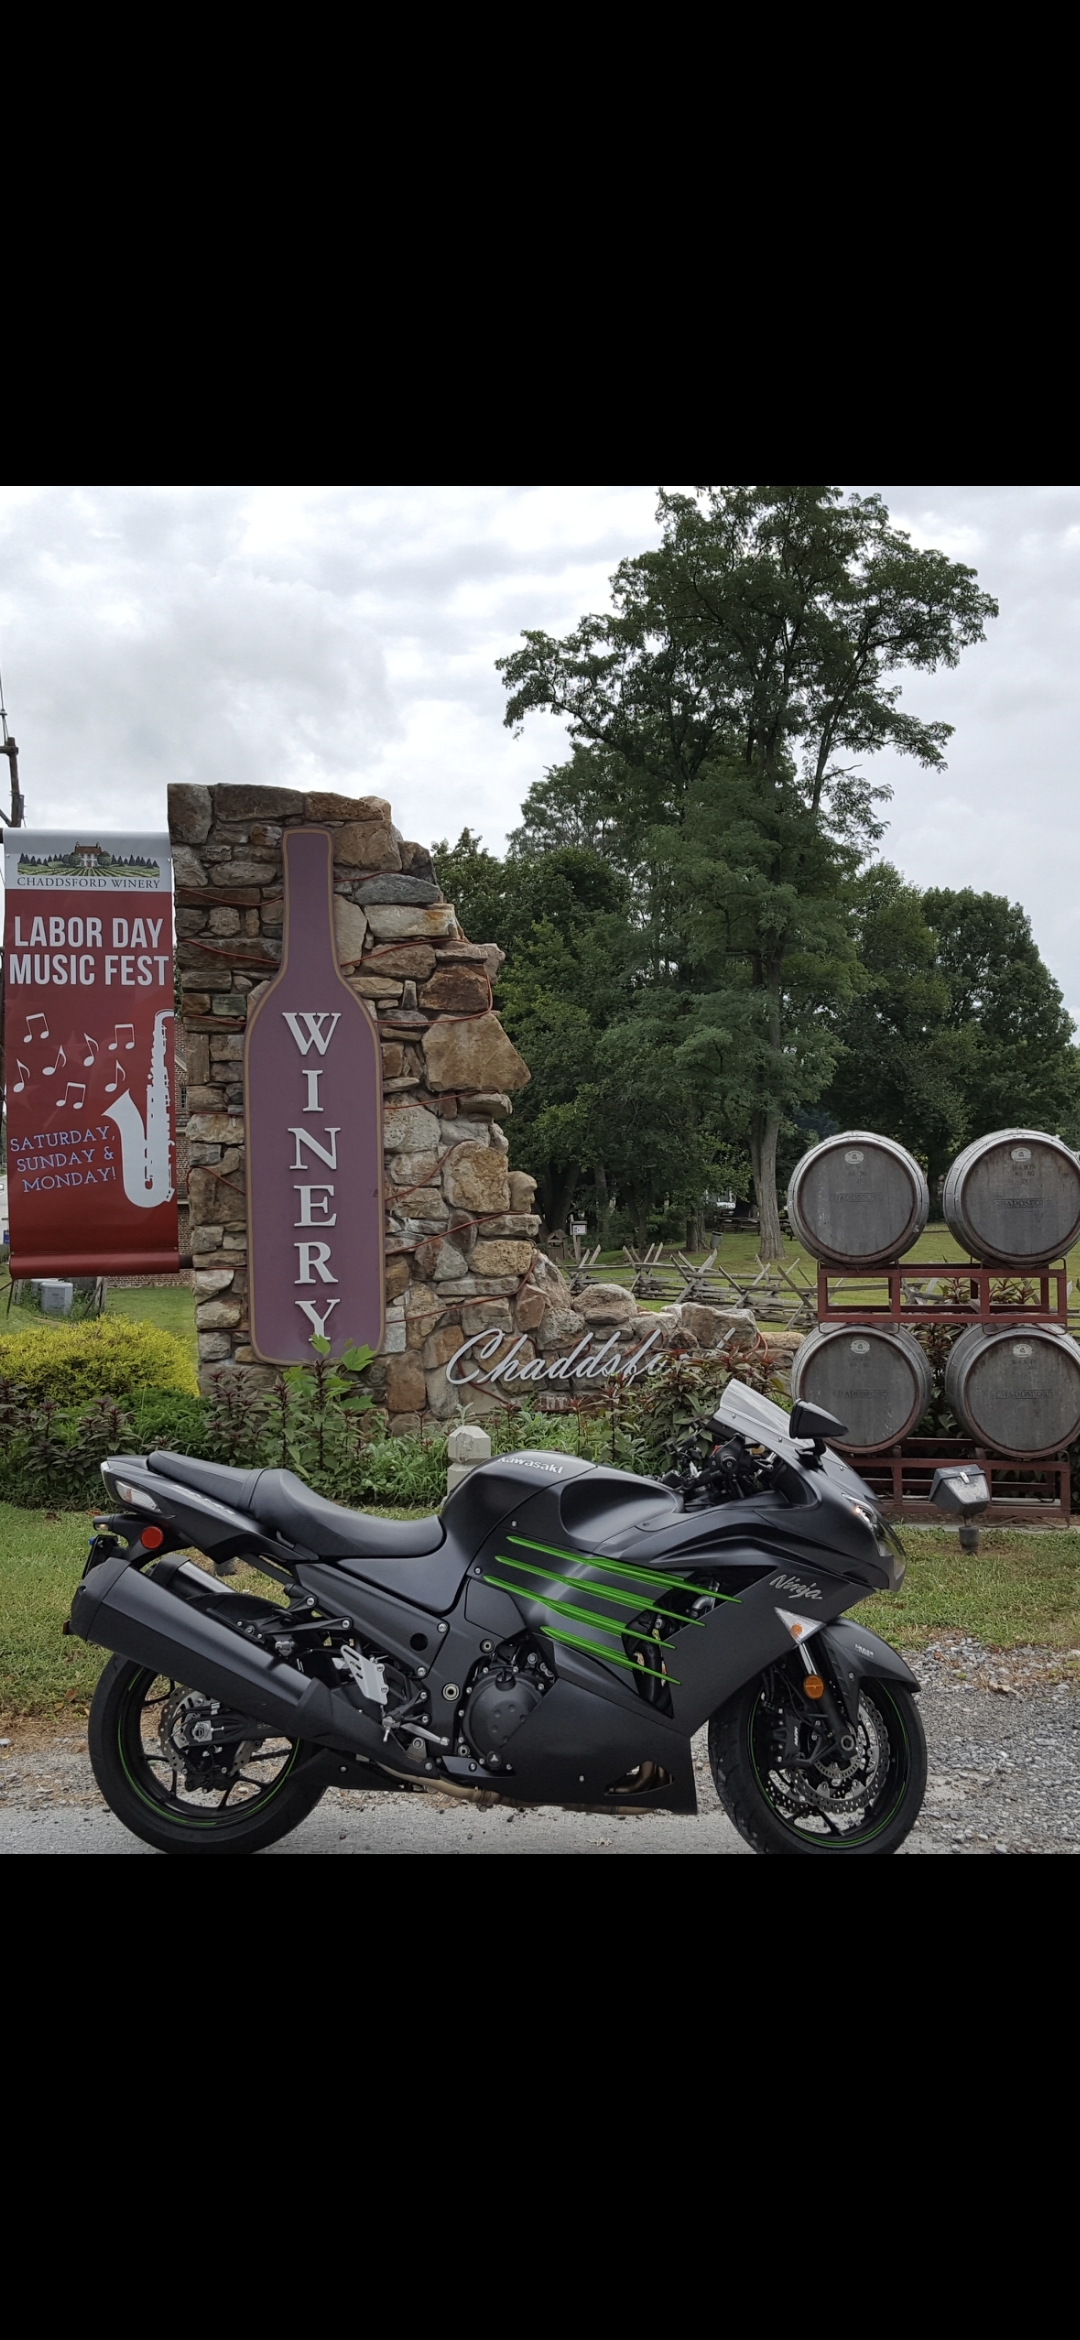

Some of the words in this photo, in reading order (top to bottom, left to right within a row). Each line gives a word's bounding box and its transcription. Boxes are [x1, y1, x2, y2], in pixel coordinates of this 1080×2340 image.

[16, 876, 107, 888] CHADDSFORD
[111, 878, 161, 889] WINERY
[14, 915, 103, 948] LABOR
[112, 917, 164, 949] DAY
[9, 953, 95, 985] MUSIC
[104, 955, 170, 986] FEST
[10, 1125, 116, 1152] SATURDAY,
[16, 1148, 95, 1172] SUNDAY
[103, 1145, 114, 1161] &
[22, 1165, 117, 1193] MONDAY!
[281, 1011, 342, 1343] WINERY
[445, 1328, 736, 1396] Chaddsfo
[769, 1574, 823, 1600] Ninja
